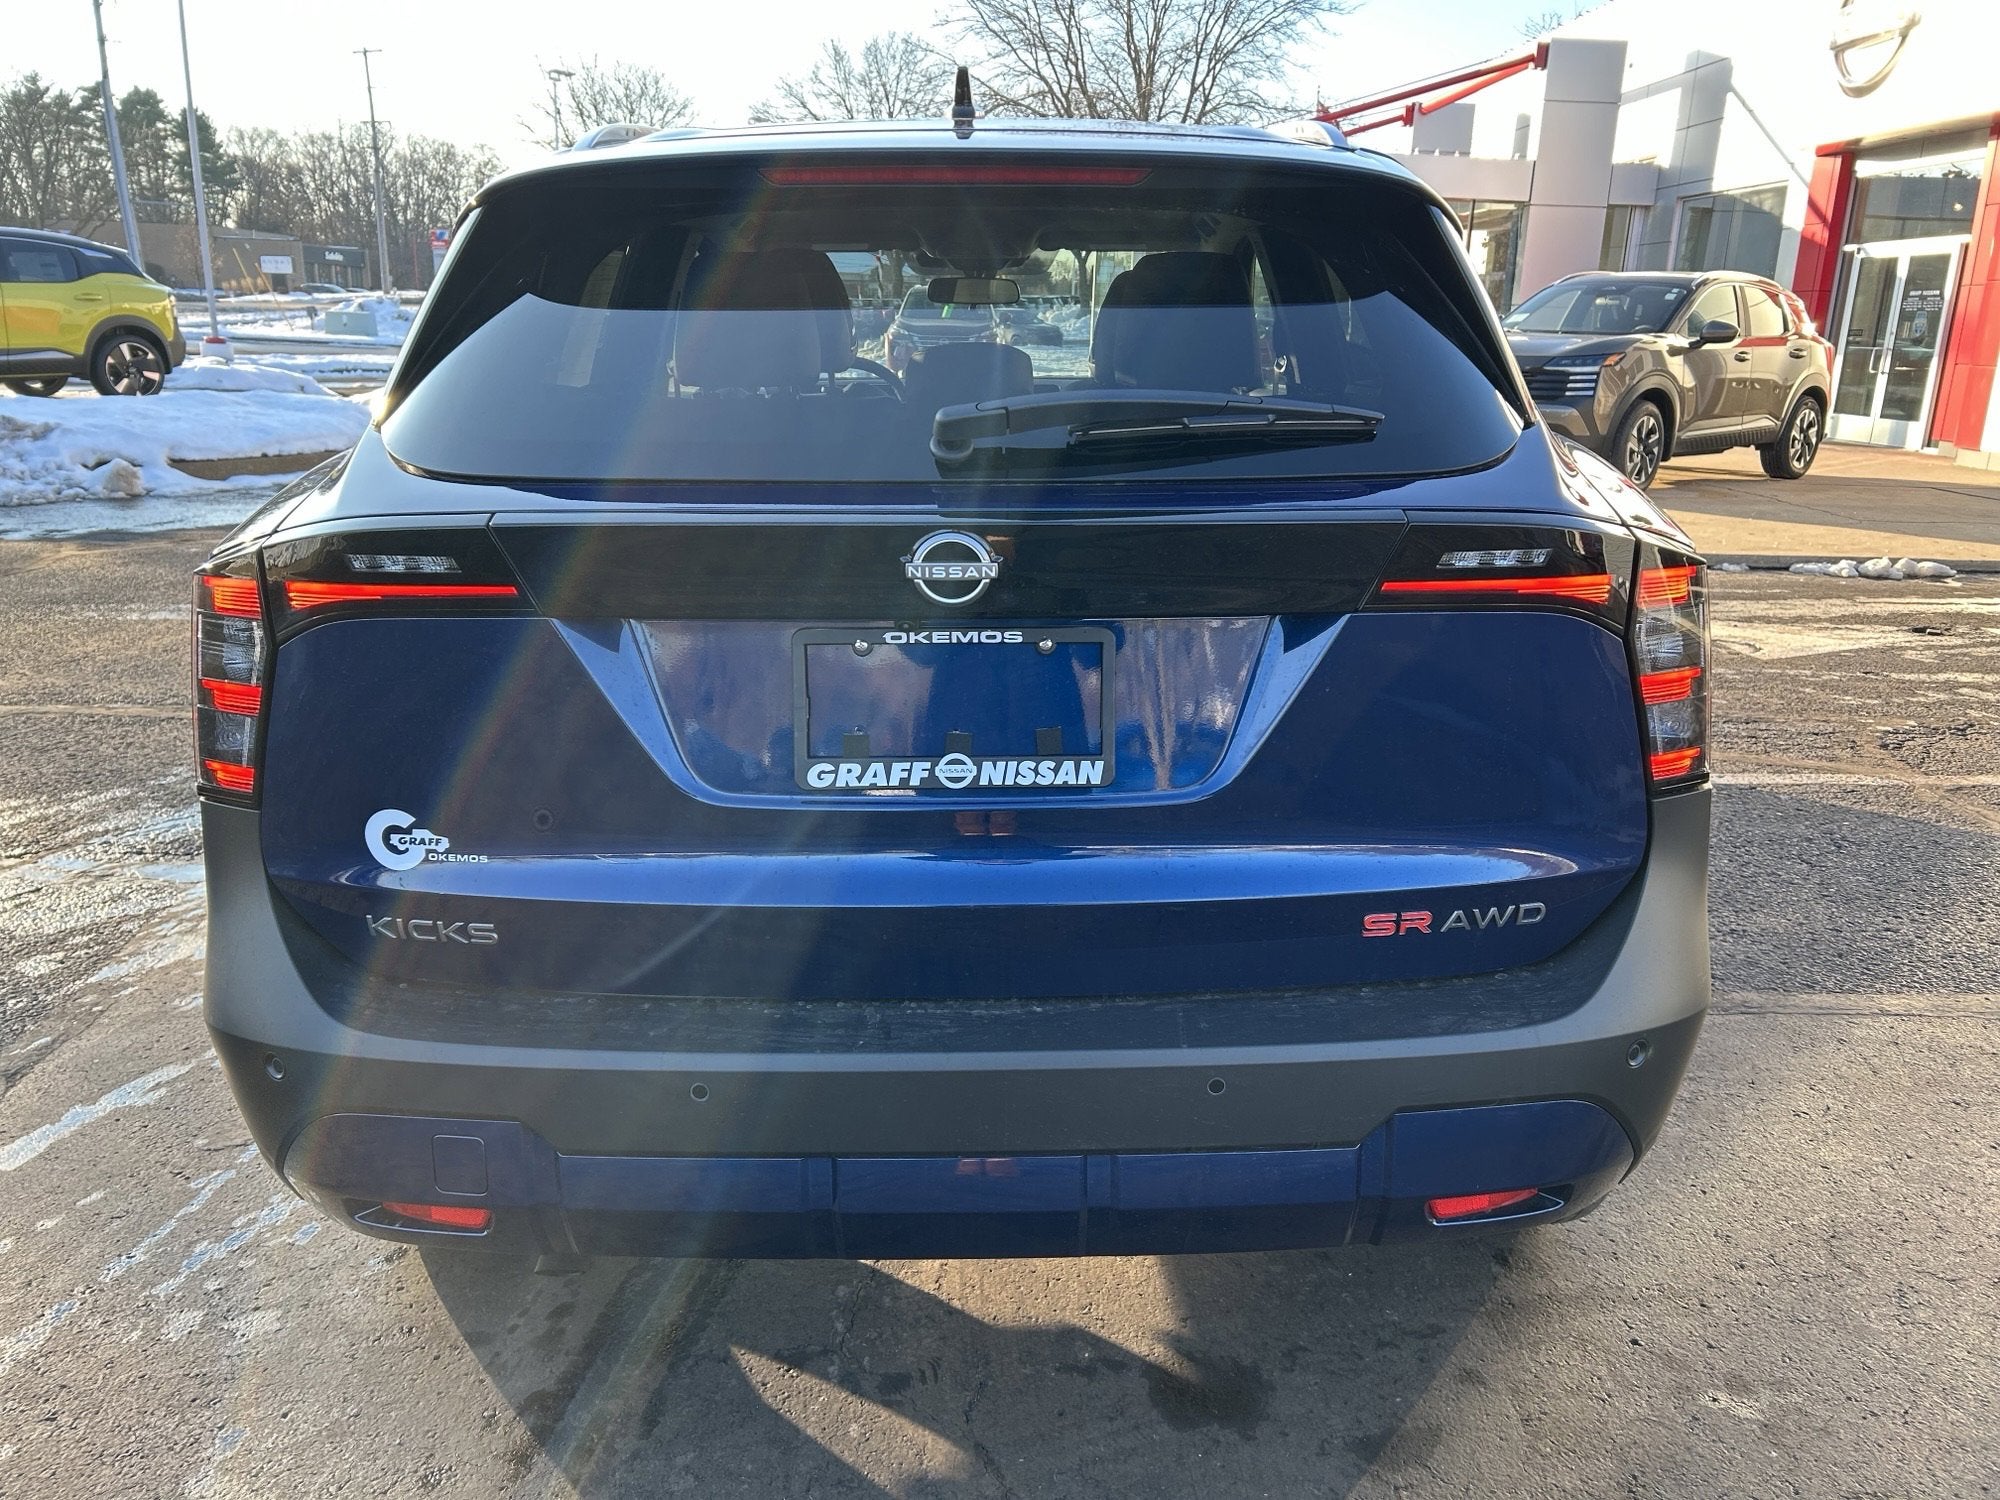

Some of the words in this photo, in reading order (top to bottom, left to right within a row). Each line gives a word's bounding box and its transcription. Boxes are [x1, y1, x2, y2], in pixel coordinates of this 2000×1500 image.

[908, 566, 996, 578] NISSAN
[882, 631, 1023, 643] OKEMOS
[806, 762, 931, 788] GRAFF
[979, 760, 1104, 785] NISSAN
[398, 836, 442, 847] GRAFF
[428, 853, 488, 863] OKEMOS
[1362, 910, 1433, 937] SR
[1440, 902, 1547, 932] AWD
[366, 915, 498, 944] KICKS
